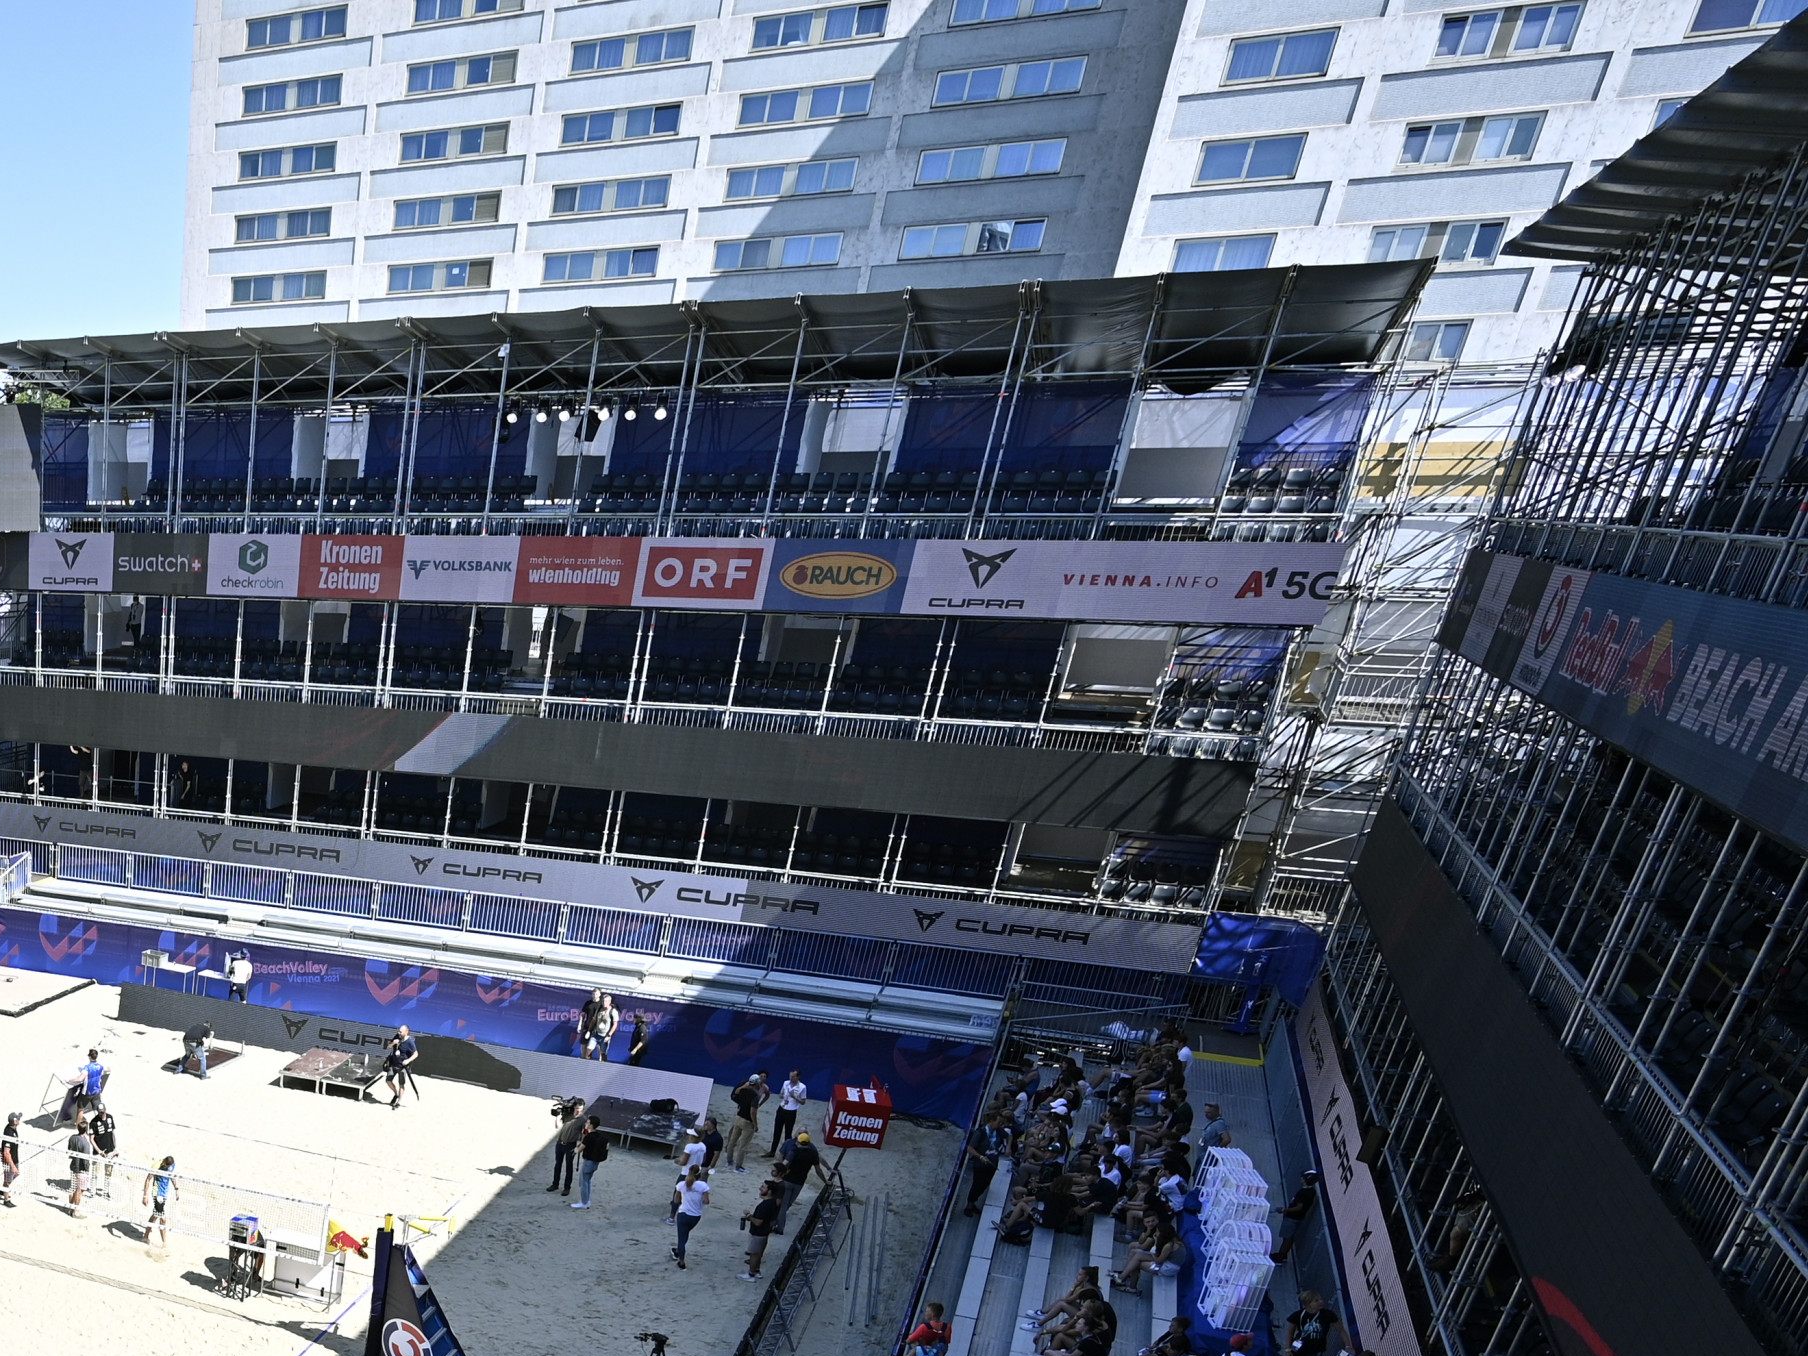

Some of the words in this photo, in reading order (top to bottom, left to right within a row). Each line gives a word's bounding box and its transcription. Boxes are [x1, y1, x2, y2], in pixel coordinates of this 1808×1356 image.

[118, 553, 189, 573] swatch
[320, 540, 383, 565] Kronen
[529, 556, 552, 564] mehr
[553, 556, 575, 565] wien
[598, 557, 625, 566] leben.
[433, 560, 512, 573] VOLKSBANK
[653, 557, 754, 589] ORF
[809, 565, 883, 586] RAUCH
[42, 576, 98, 586] CUPRA
[221, 575, 284, 590] checkrobin
[318, 566, 381, 593] Zeitung
[1063, 573, 1219, 589] VIENNA.INFO
[1234, 567, 1279, 599] A1
[928, 597, 1025, 610] CUPRA
[1666, 643, 1788, 754] BEACH
[59, 821, 137, 840] CUPRA
[233, 837, 341, 863] CUPRA
[442, 862, 544, 885] CUPRA
[676, 886, 820, 917] CUPRA
[955, 917, 1091, 946] CUPRA
[287, 974, 321, 983] Vienna
[323, 974, 340, 983] 2021
[837, 1111, 883, 1129] Kronen
[833, 1126, 879, 1144] Zeitung
[1329, 1114, 1355, 1195] CUPRA
[1362, 1248, 1391, 1342] CUPRA
